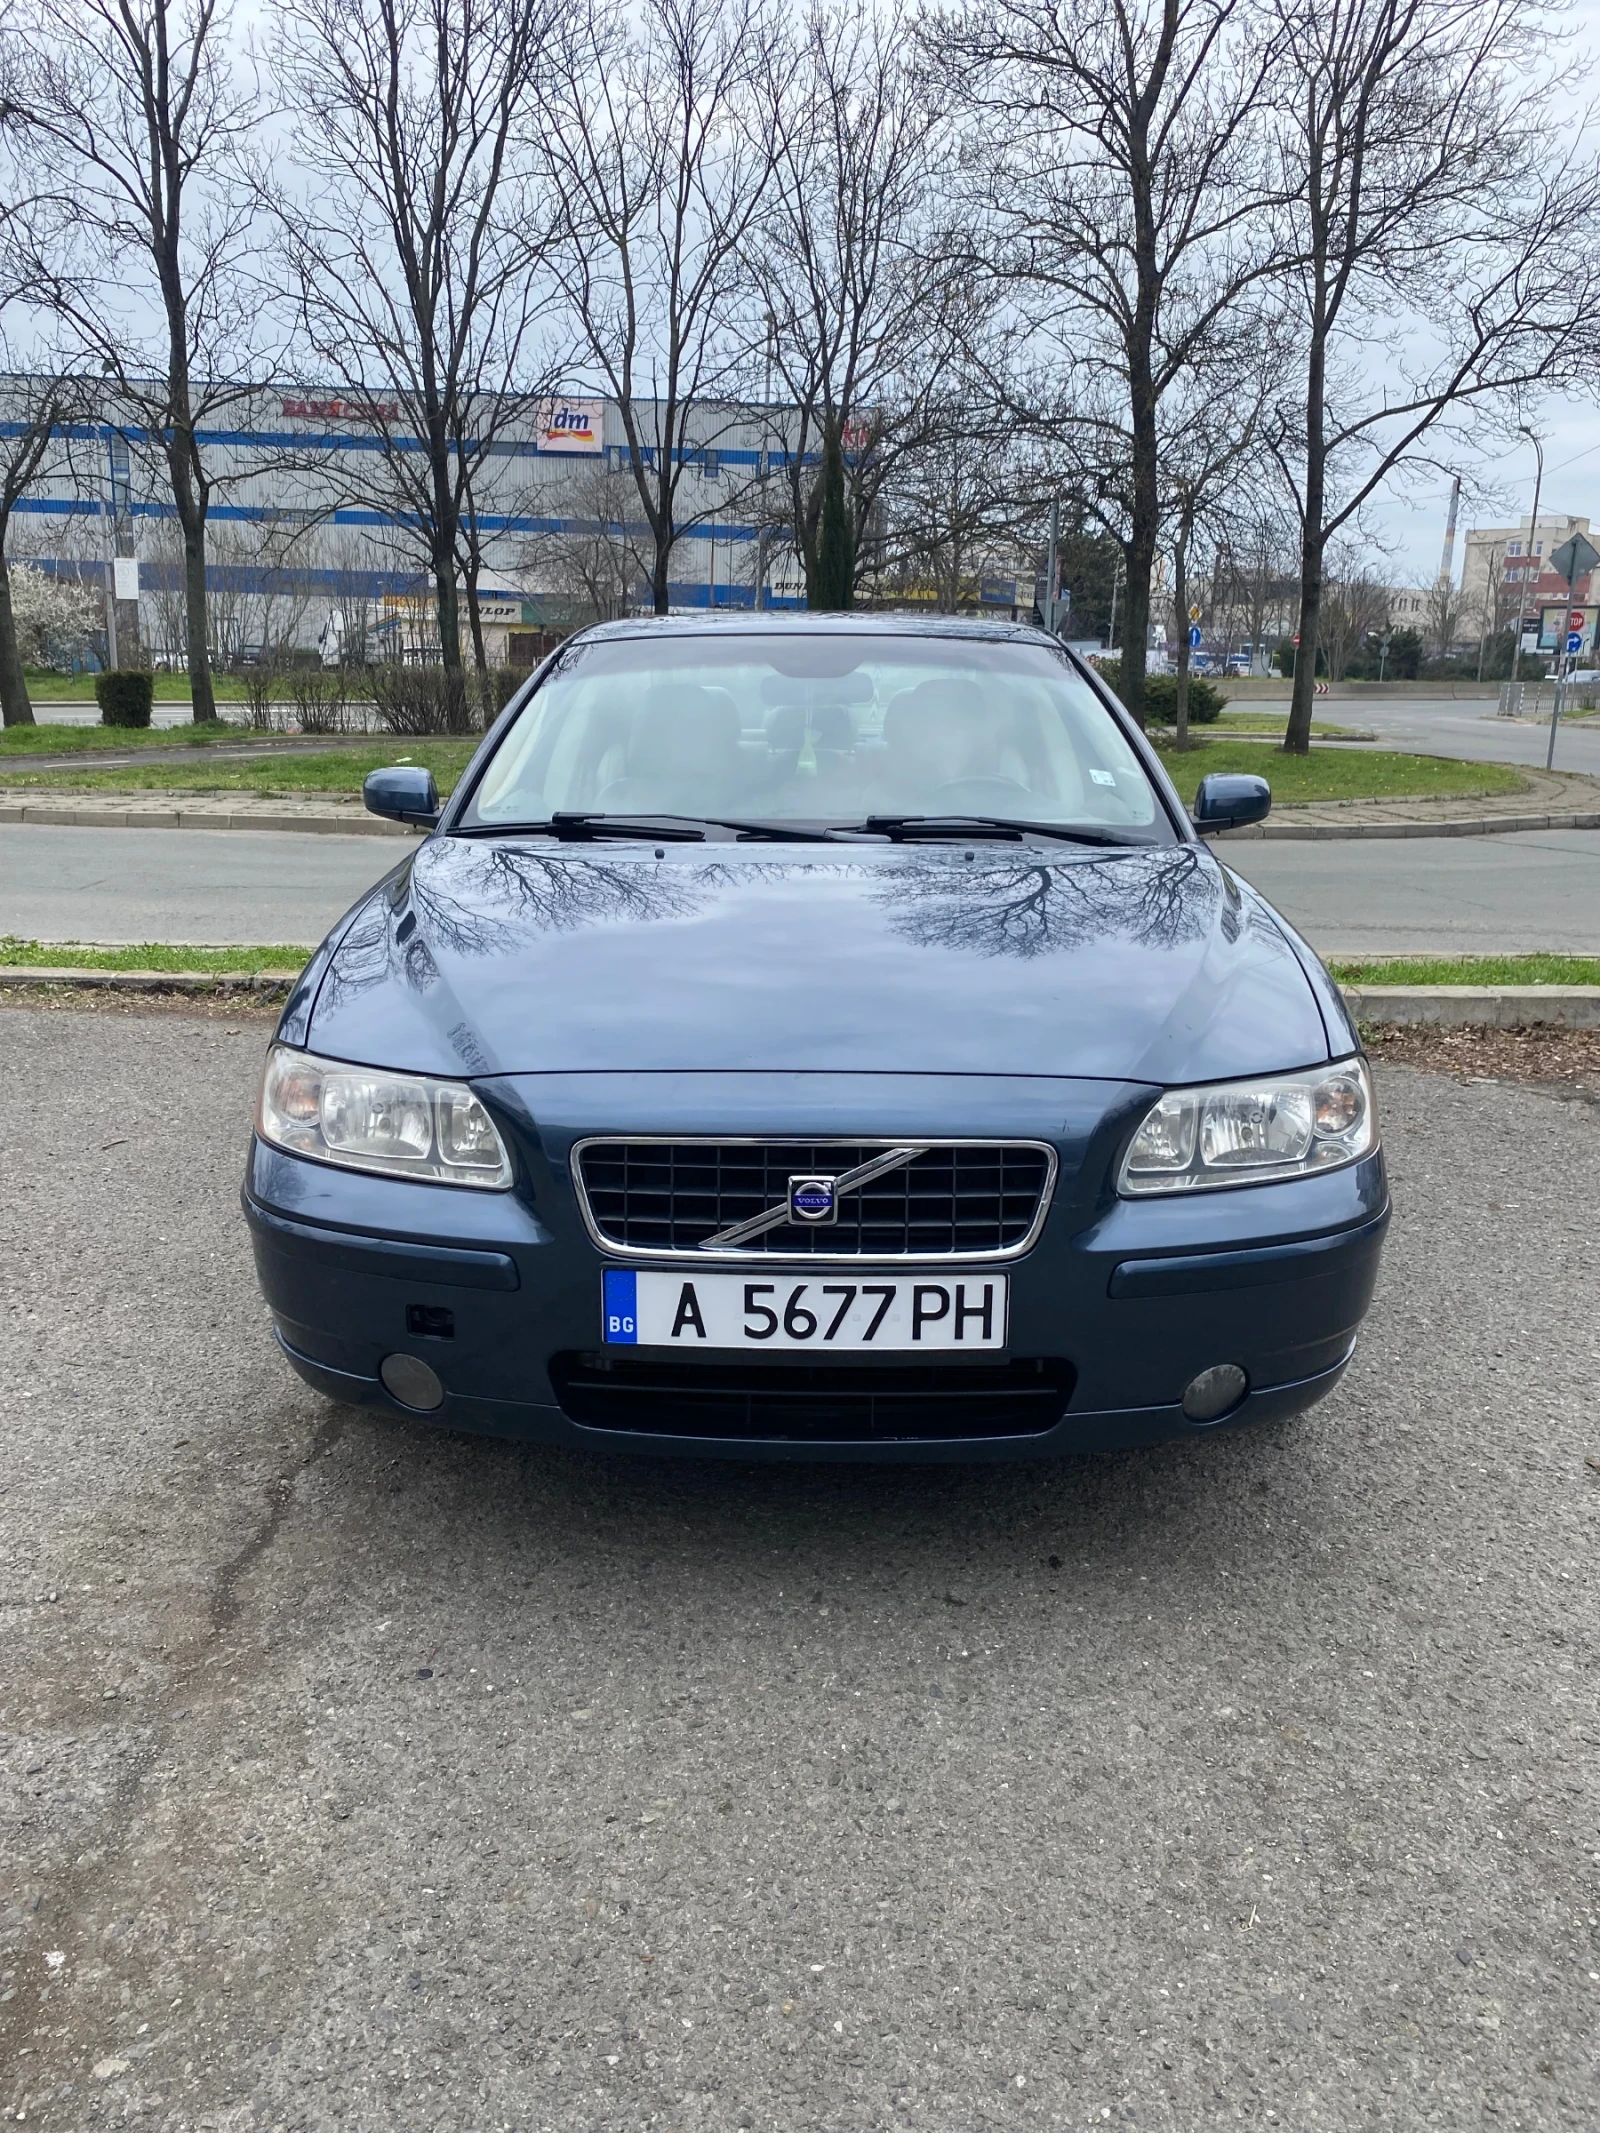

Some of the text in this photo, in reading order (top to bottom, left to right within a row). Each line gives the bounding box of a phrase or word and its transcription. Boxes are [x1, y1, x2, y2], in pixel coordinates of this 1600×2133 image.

[554, 408, 589, 429] dm
[1570, 617, 1583, 627] TOP
[671, 1282, 993, 1341] A 5677 PH
[609, 1315, 634, 1333] BG
